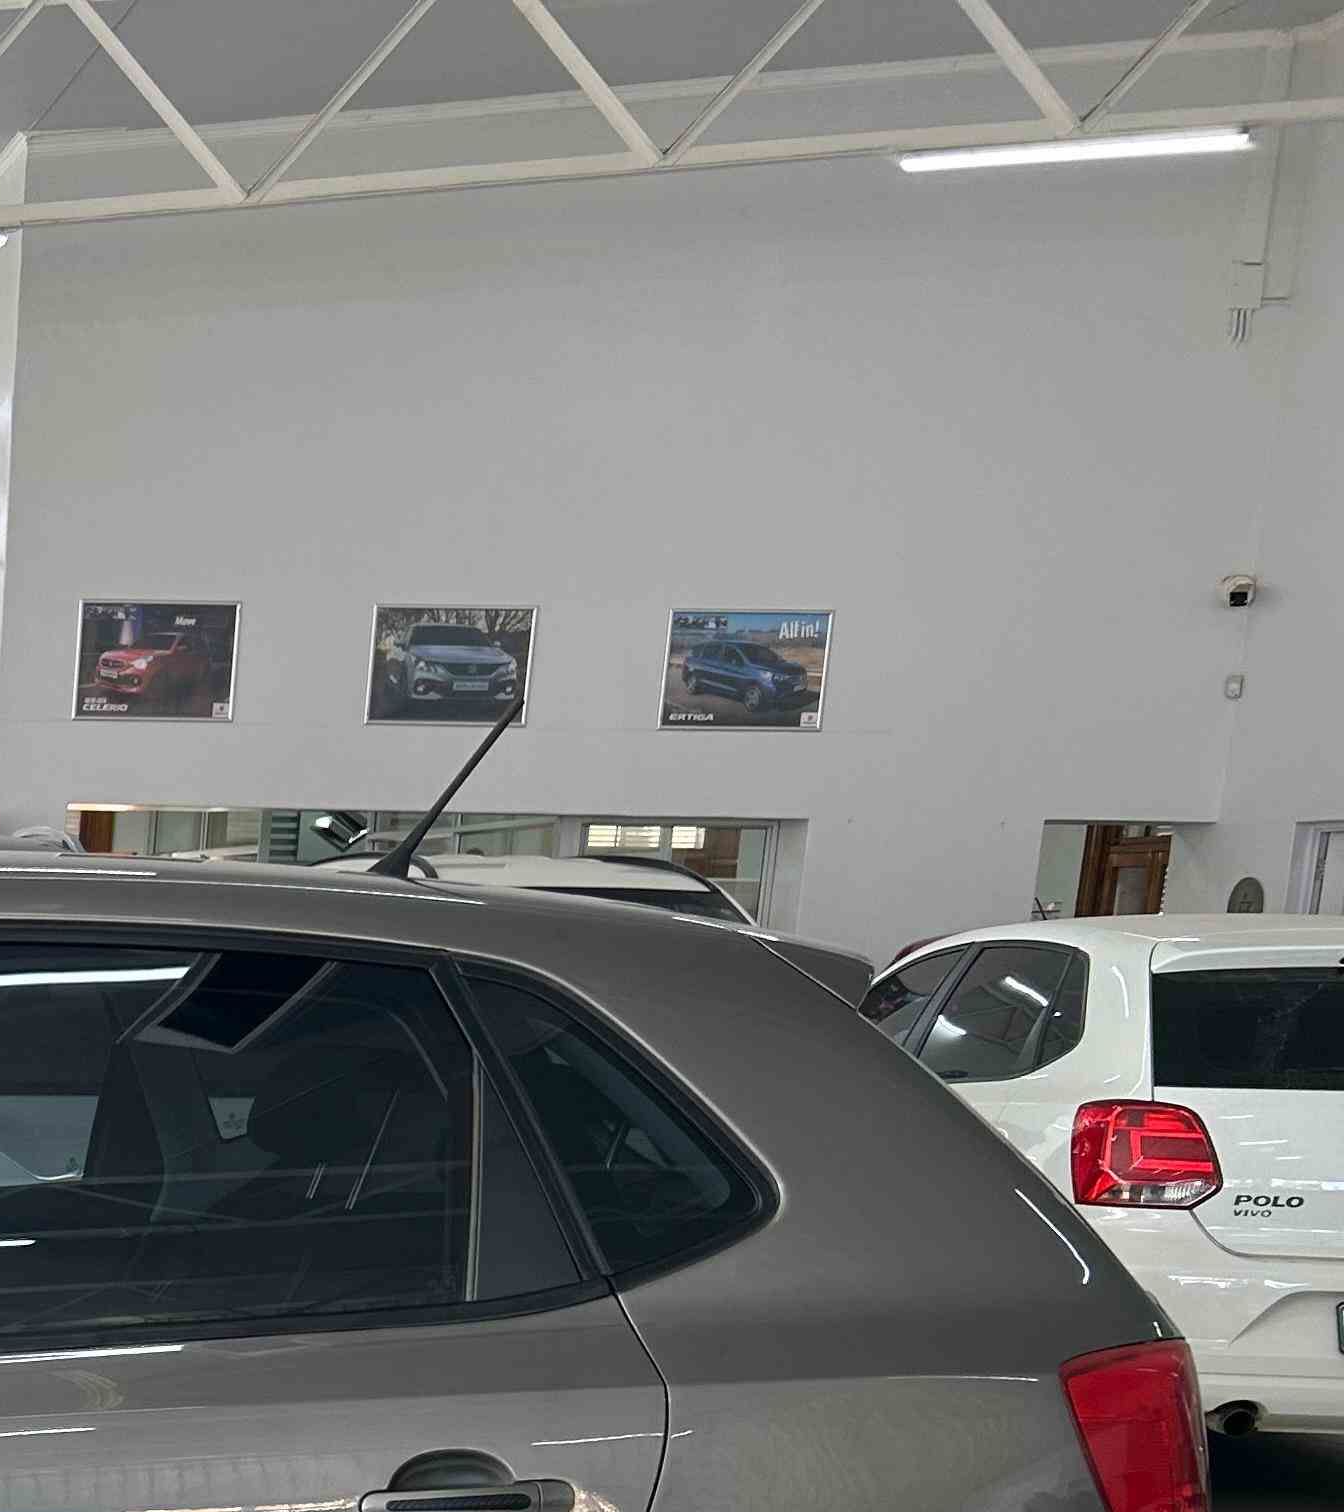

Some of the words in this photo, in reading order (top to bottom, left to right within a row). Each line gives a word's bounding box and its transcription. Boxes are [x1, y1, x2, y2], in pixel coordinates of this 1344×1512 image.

[82, 703, 129, 712] CELERIO
[668, 712, 714, 721] ERTIGA
[1233, 1194, 1305, 1208] POLO
[1233, 1209, 1272, 1218] VIVO
